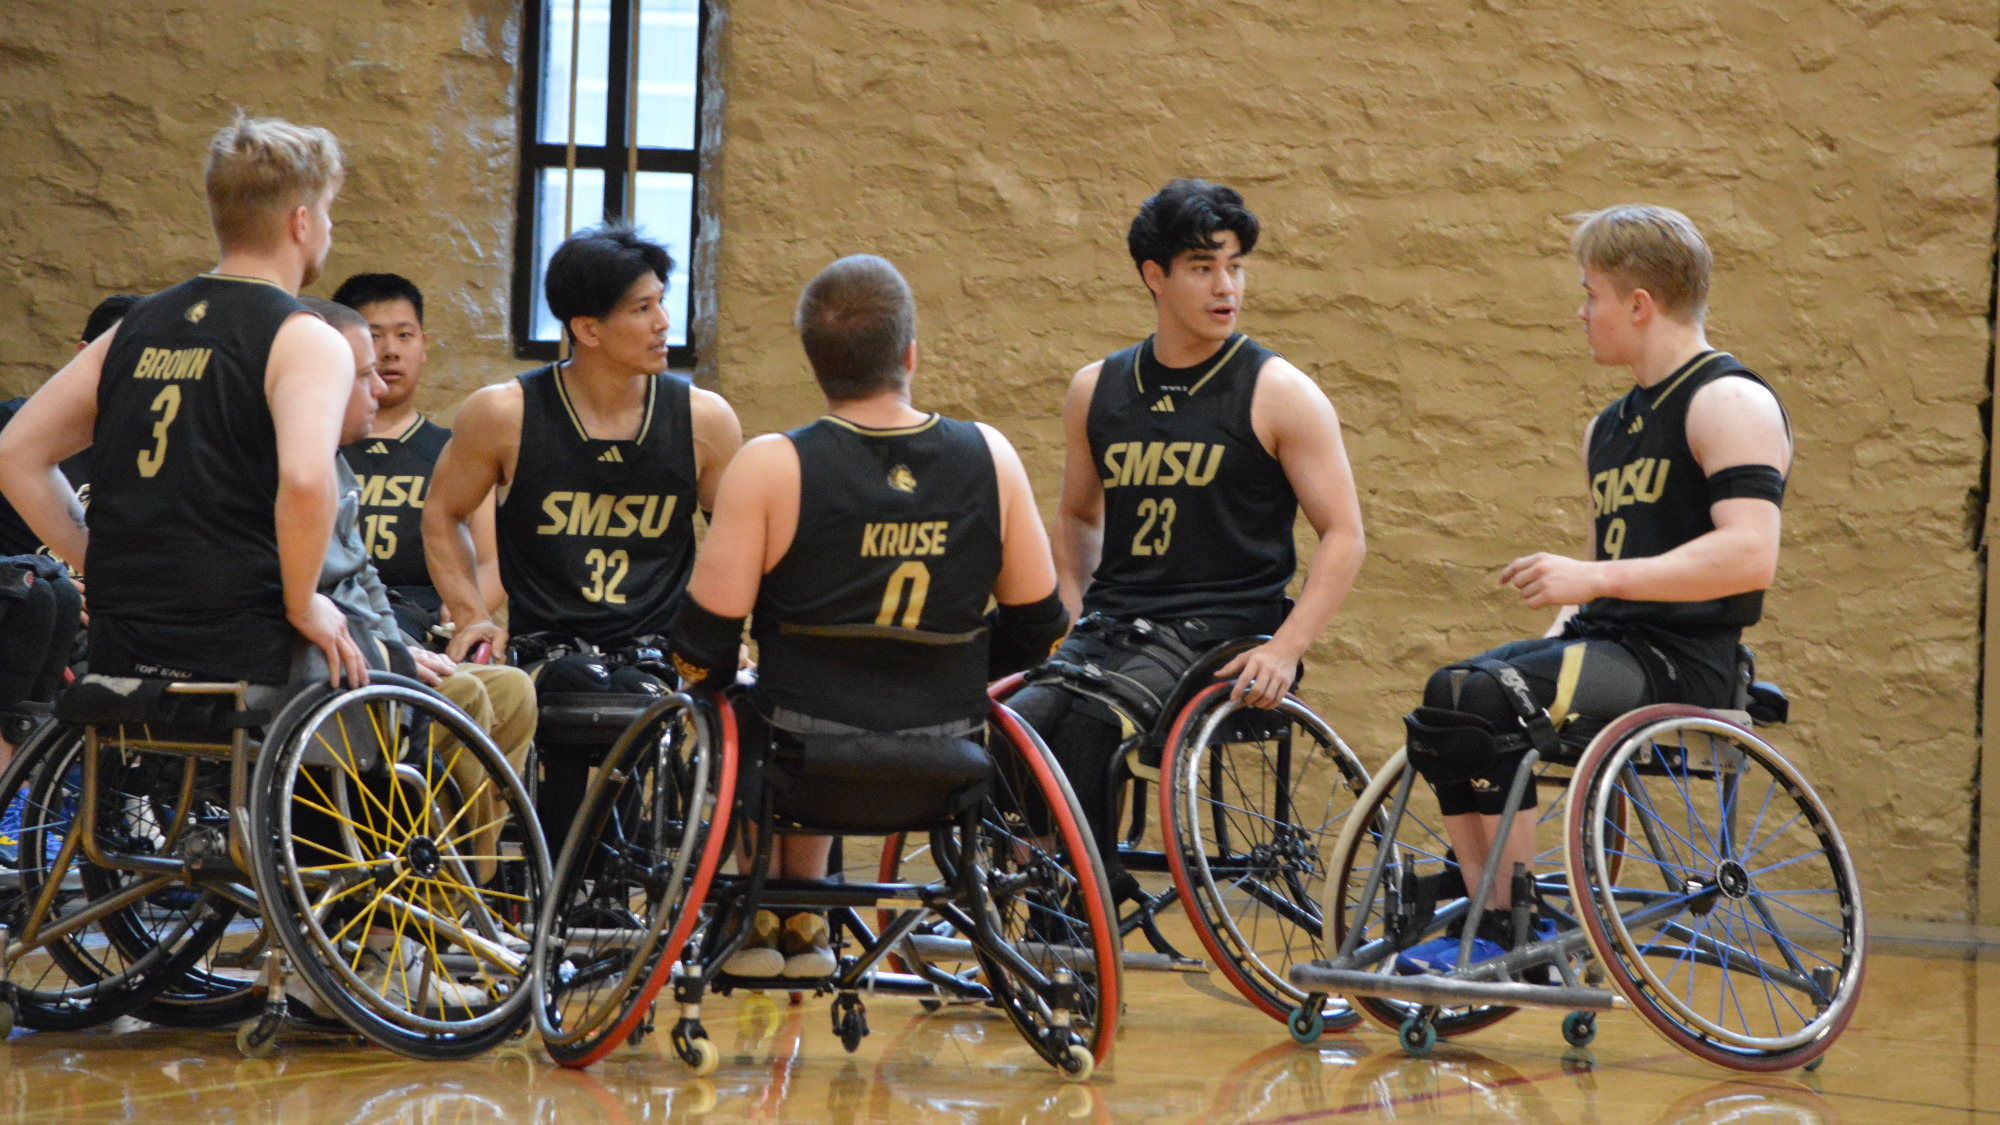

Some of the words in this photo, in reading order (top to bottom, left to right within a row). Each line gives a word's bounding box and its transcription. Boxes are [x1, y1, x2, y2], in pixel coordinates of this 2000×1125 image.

[133, 346, 213, 380] BROWN
[136, 384, 182, 478] 3
[1103, 441, 1226, 488] SMSU
[354, 474, 425, 508] MSU
[536, 491, 678, 538] SMSU
[364, 514, 399, 560] 15
[861, 521, 949, 557] KRUSE
[1131, 497, 1177, 556] 23
[1603, 517, 1627, 561] 9
[581, 548, 629, 604] 32
[874, 560, 931, 631] 0
